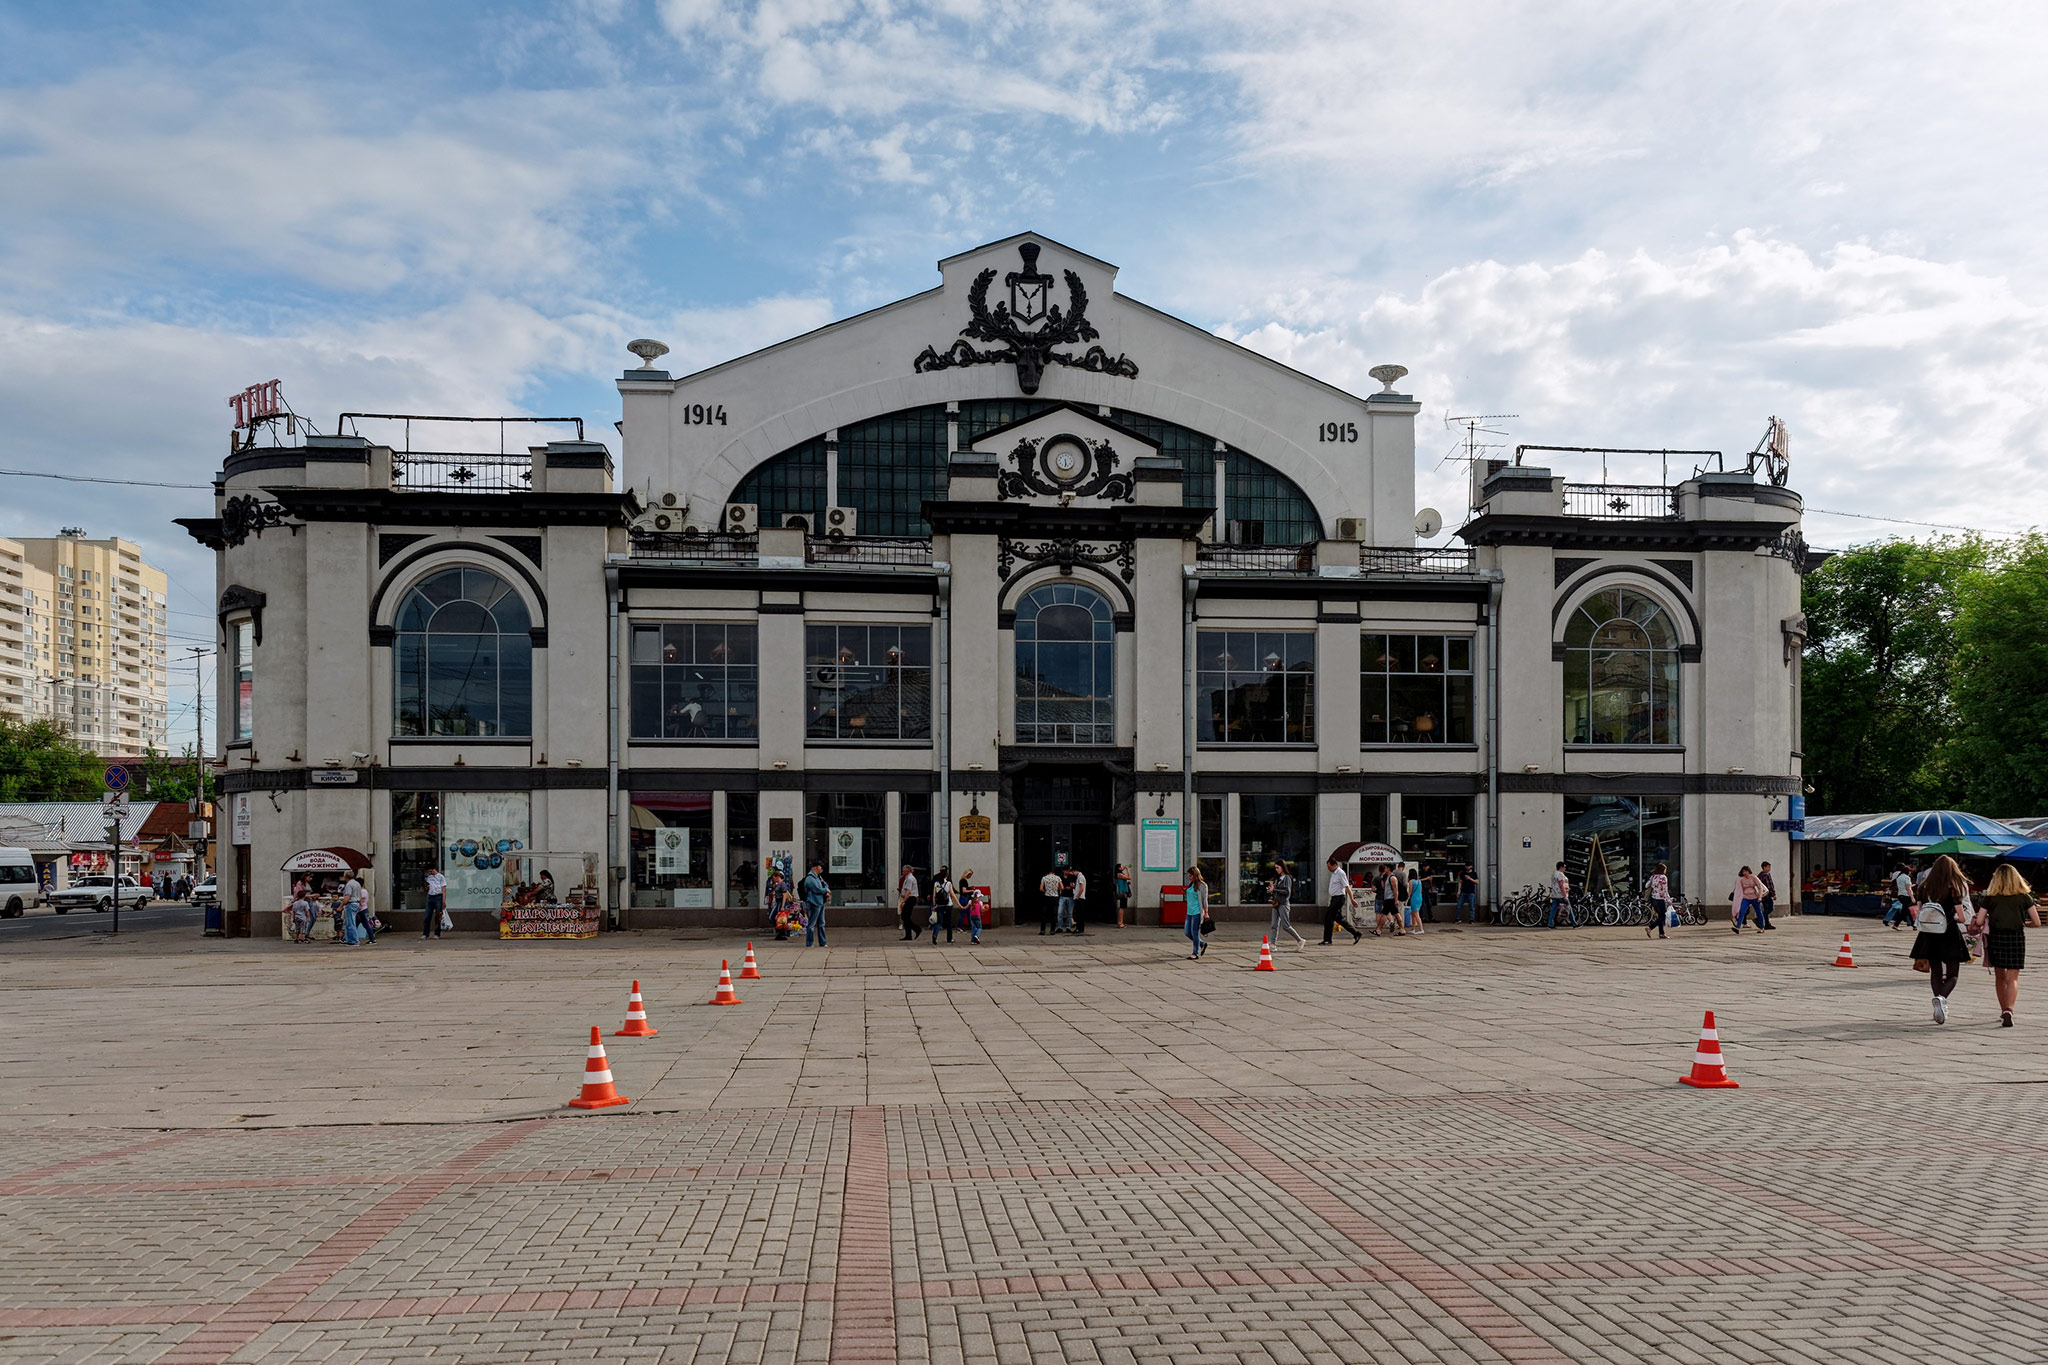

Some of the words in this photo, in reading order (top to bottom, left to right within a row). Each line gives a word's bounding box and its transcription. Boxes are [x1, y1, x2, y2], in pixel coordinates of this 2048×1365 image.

[684, 404, 727, 426] 1914
[1319, 422, 1358, 443] 1915
[1358, 845, 1396, 855] ГАЗИРОВАННАЯ
[295, 852, 340, 862] ГАЗИРОВАННАЯ
[514, 908, 579, 920] НАРОДНОЕ
